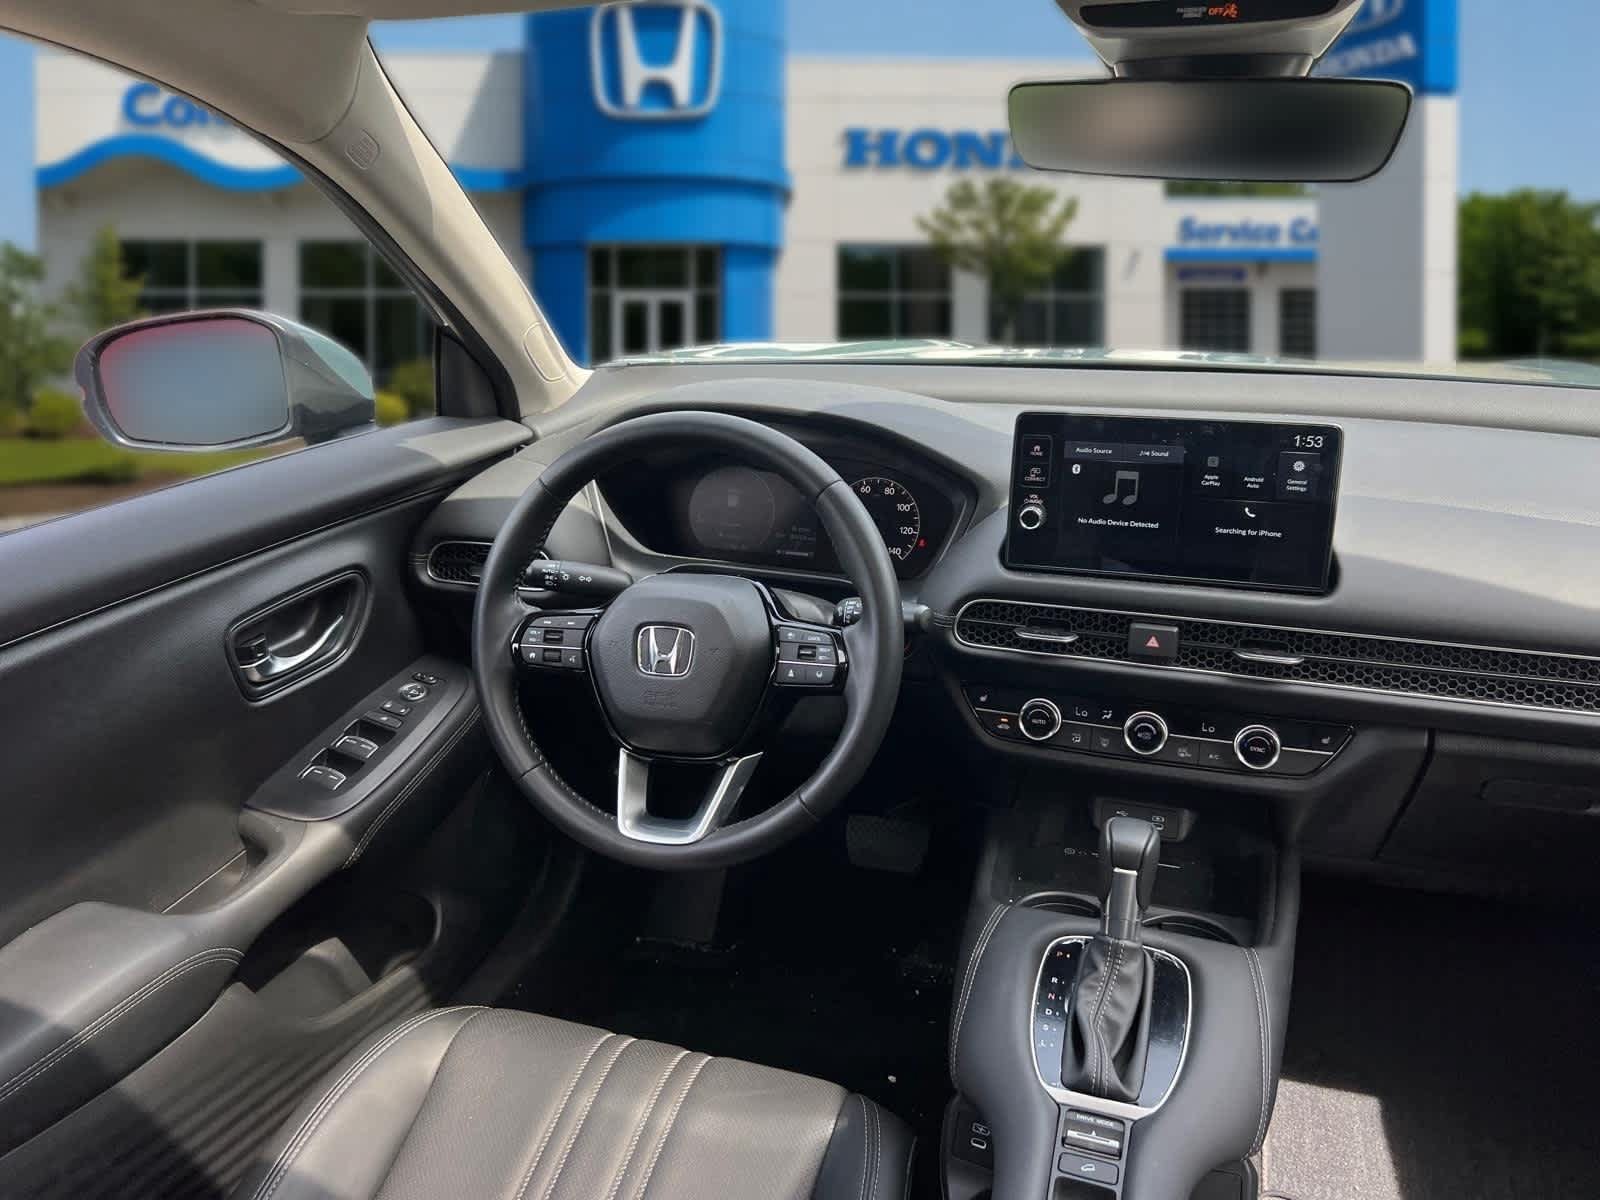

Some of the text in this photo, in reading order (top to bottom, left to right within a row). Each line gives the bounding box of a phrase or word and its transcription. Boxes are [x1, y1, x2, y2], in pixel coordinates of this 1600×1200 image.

[1208, 8, 1224, 16] OFF
[843, 128, 1024, 169] HON
[1179, 216, 1280, 242] Service
[1294, 435, 1324, 448] 1:53
[1093, 447, 1112, 455] Source
[860, 486, 871, 494] 60
[884, 487, 895, 496] 80
[896, 503, 911, 512] 100
[1107, 519, 1129, 527] Device
[1129, 521, 1159, 529] Detected
[899, 526, 914, 535] 120
[1215, 526, 1282, 538] Searching for iPhone
[888, 547, 902, 555] 140
[1075, 706, 1088, 718] Lo
[1201, 722, 1215, 733] Lo
[1249, 746, 1266, 754] SYNC
[1051, 976, 1058, 984] R
[1048, 992, 1056, 1000] N
[1045, 1008, 1053, 1016] D
